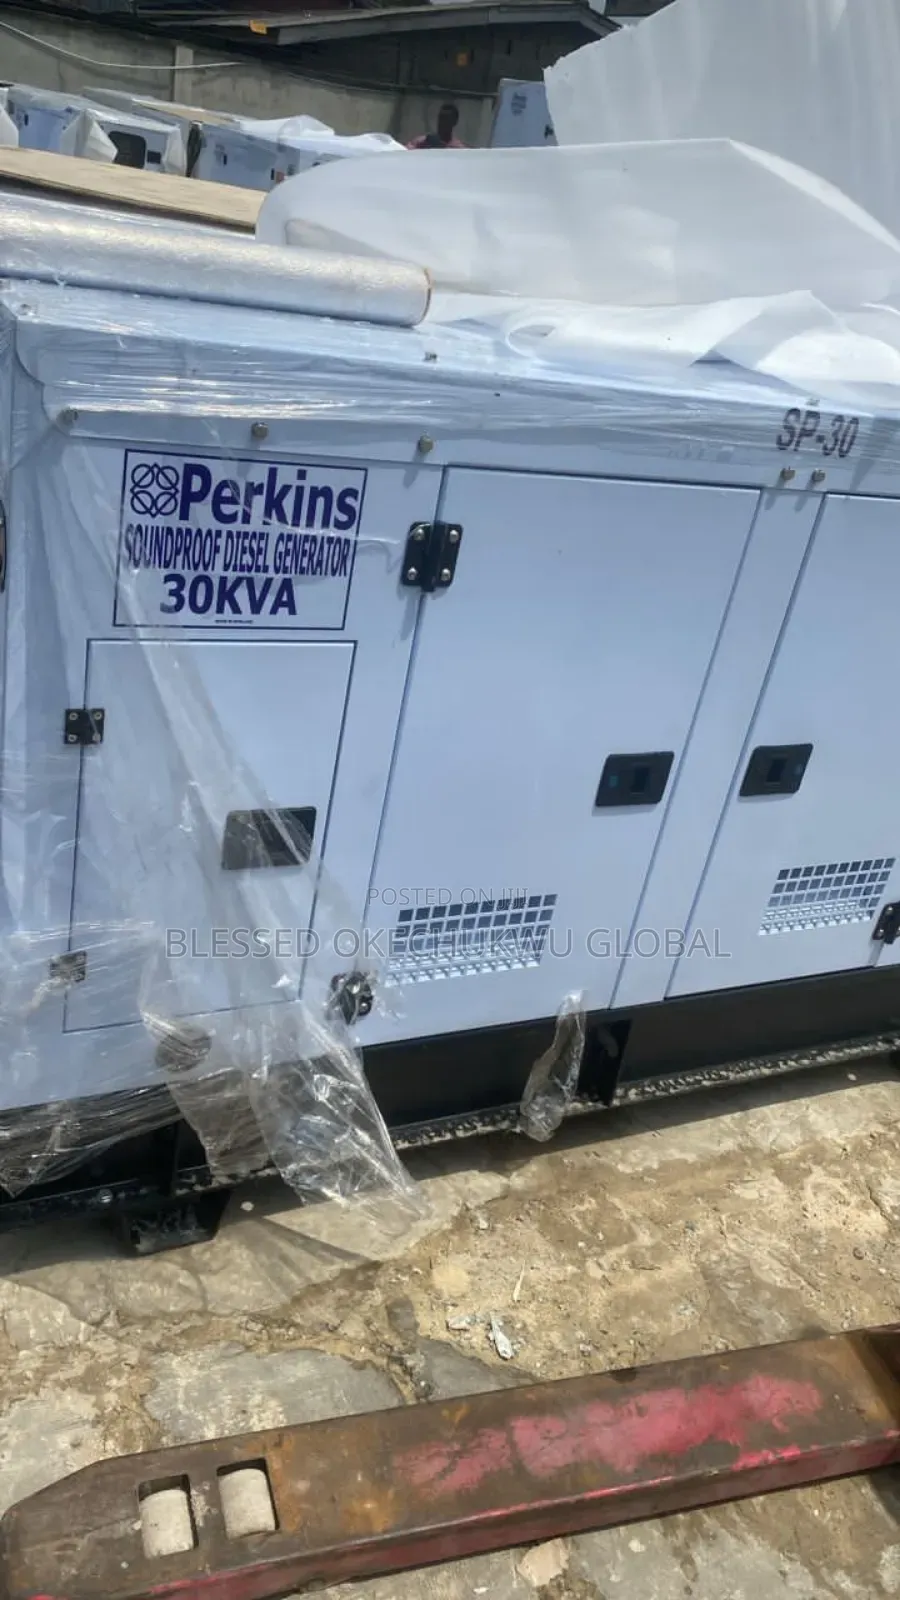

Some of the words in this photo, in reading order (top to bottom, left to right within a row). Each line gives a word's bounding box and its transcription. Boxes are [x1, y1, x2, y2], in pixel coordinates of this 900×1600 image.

[776, 408, 860, 458] SP-30
[178, 462, 360, 531] Perkins
[124, 523, 222, 572] SOUNDPROOF
[222, 529, 270, 574] DIESEL
[273, 533, 351, 577] GENERATOR
[159, 573, 297, 616] 30KVA
